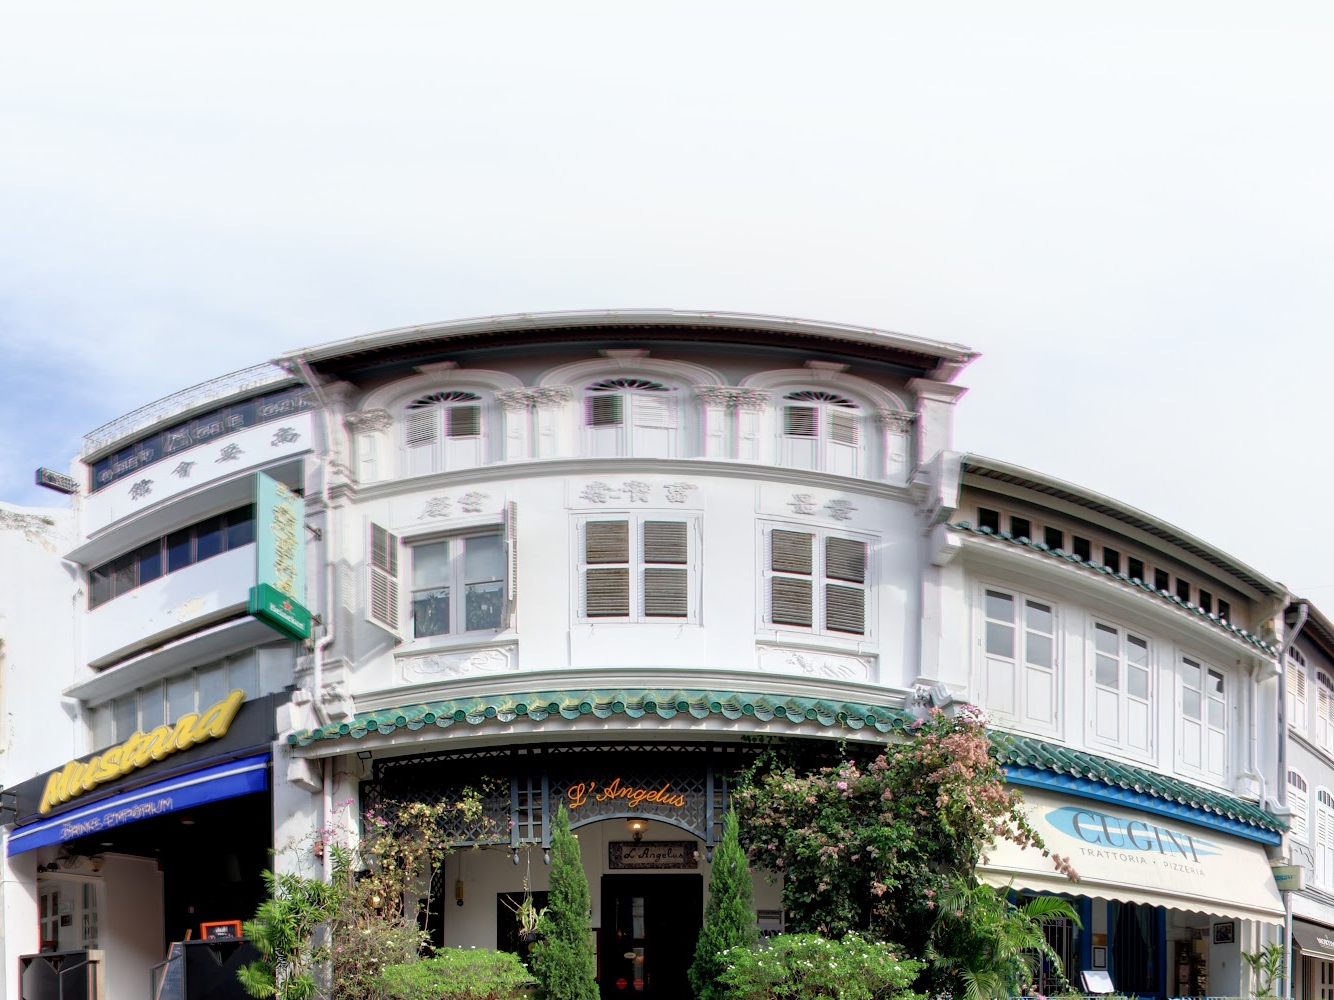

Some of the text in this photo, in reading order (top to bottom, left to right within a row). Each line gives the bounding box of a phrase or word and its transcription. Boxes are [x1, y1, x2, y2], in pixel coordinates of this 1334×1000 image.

[38, 687, 247, 815] Mustard
[104, 798, 174, 827] EMPORIUM
[1072, 811, 1202, 864] CUGINI
[1078, 847, 1206, 877] TRATTORIA PIZZERIA
